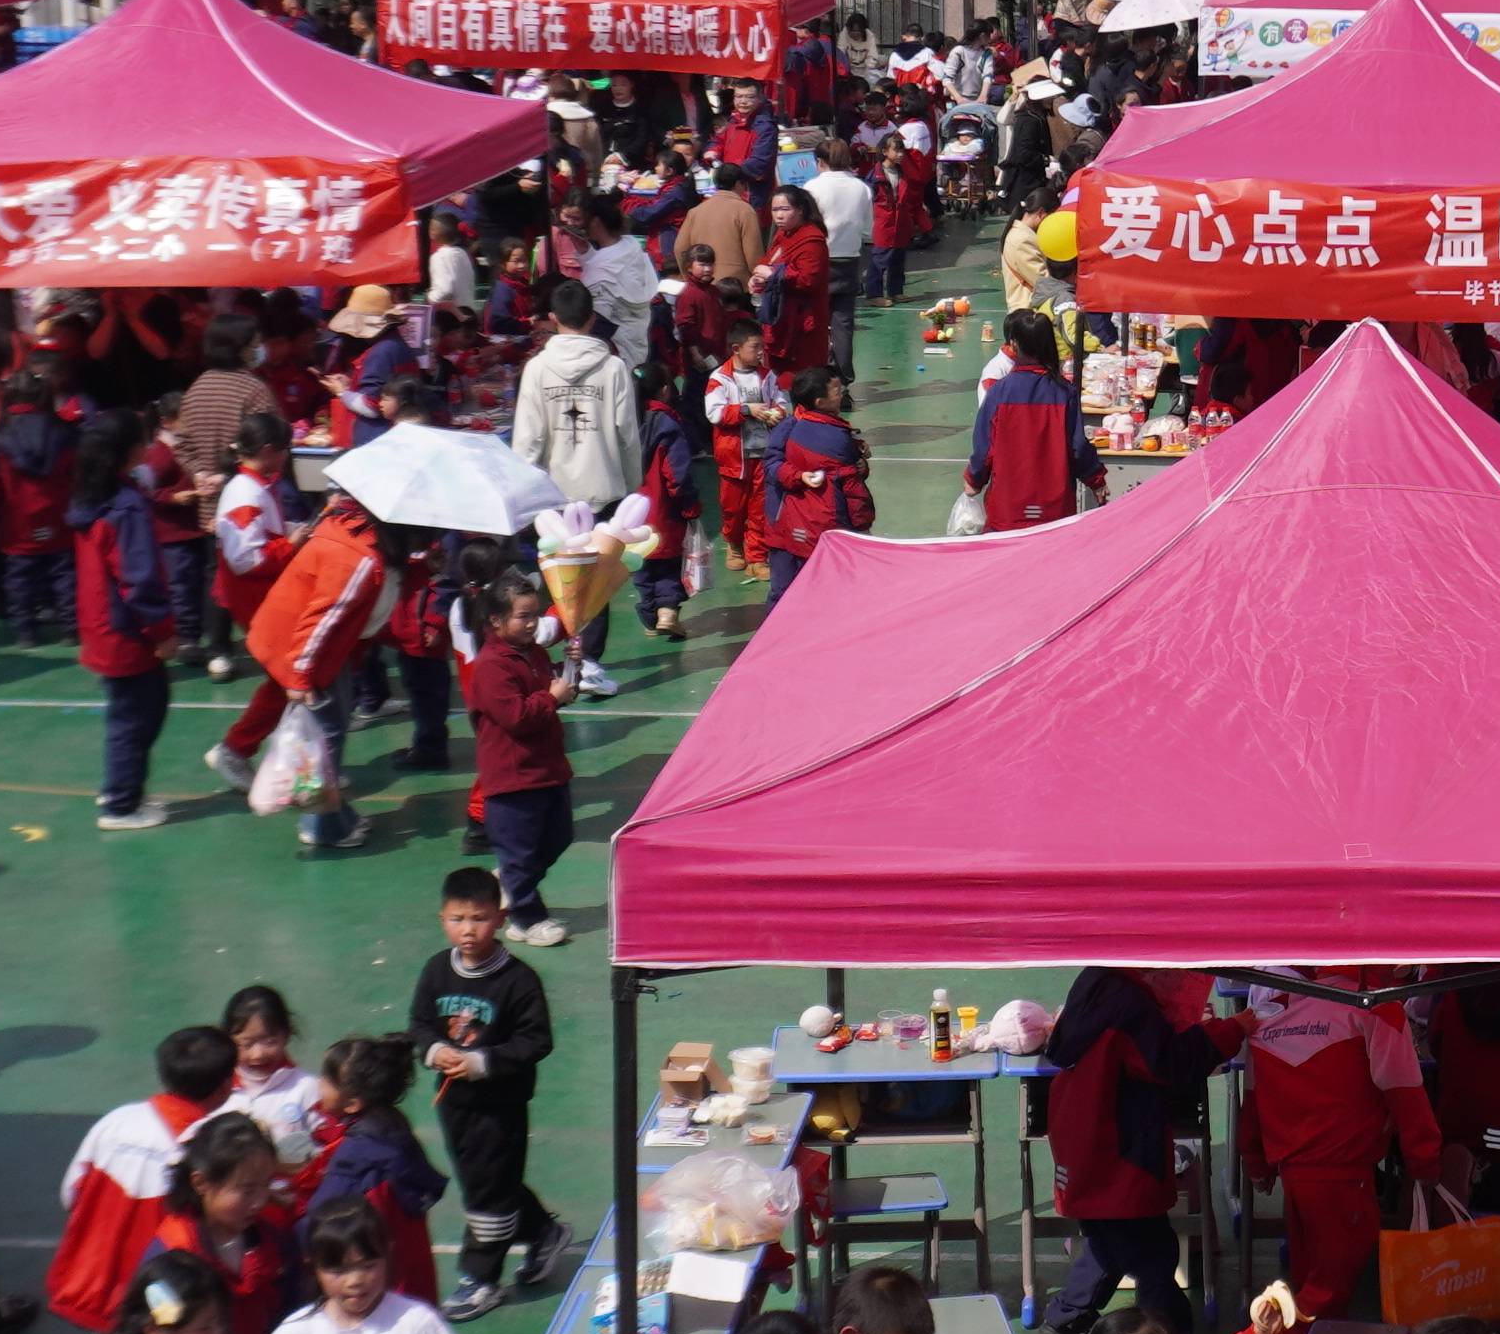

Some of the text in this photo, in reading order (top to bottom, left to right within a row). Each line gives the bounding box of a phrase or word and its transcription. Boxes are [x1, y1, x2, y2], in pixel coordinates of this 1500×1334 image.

[587, 1, 773, 62] 爱心捐款暖人心
[92, 172, 368, 235] 义卖传真情
[1099, 184, 1381, 268] 爱心点点
